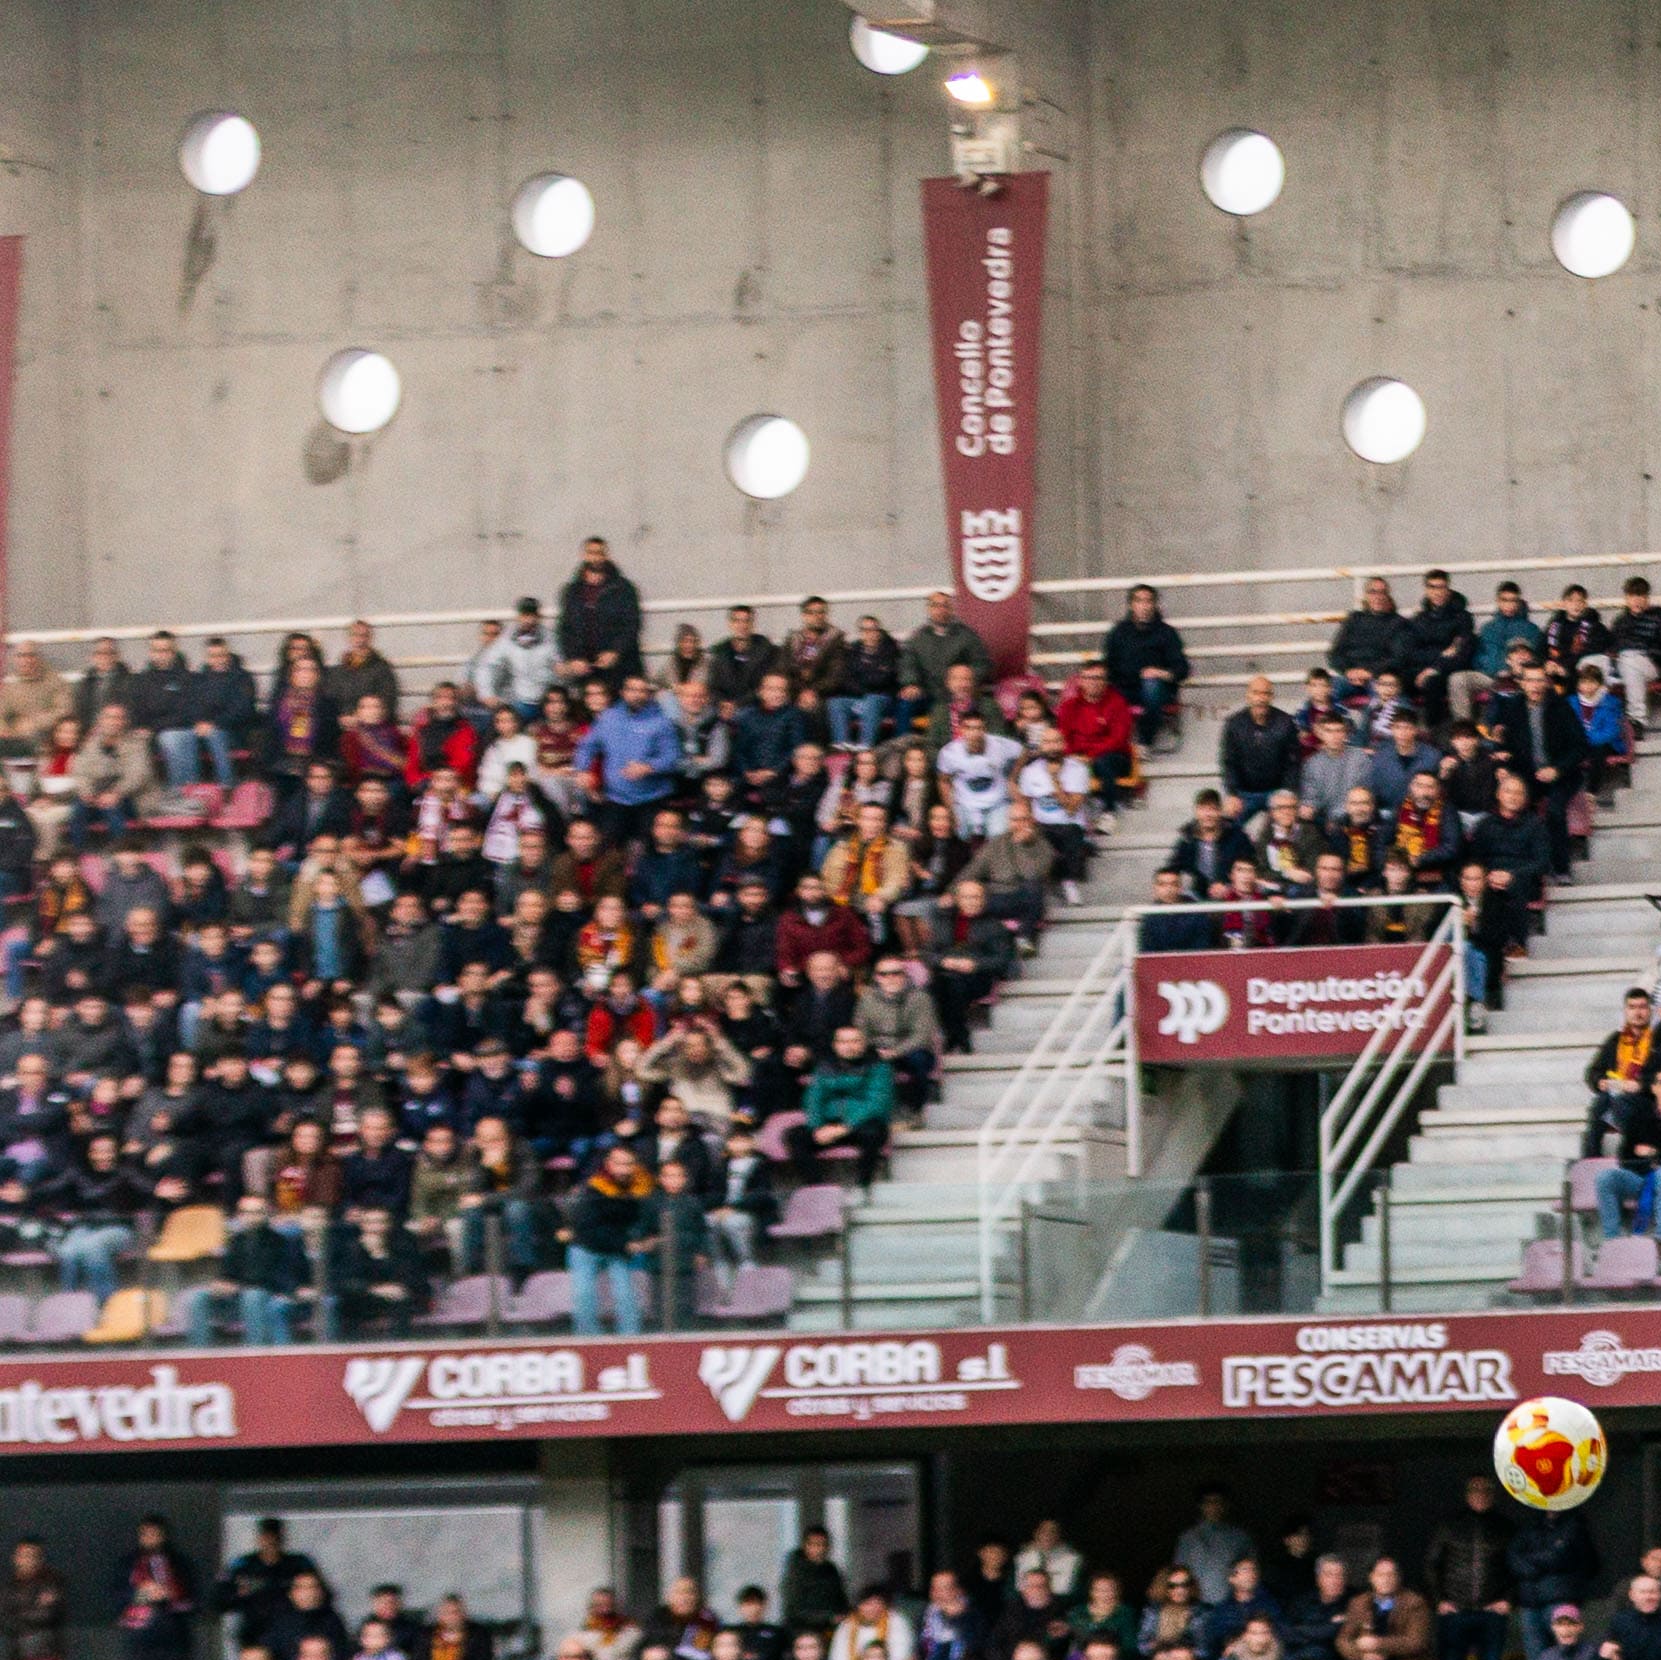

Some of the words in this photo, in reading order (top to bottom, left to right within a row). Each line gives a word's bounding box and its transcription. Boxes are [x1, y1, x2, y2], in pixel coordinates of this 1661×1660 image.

[981, 226, 1015, 409] Pontevedra
[953, 319, 986, 458] Concello
[984, 413, 1016, 456] de
[1245, 970, 1426, 1011] Deputación
[1246, 1003, 1426, 1036] Pontevedra
[1296, 1323, 1448, 1352] CONSERVAS
[426, 1350, 583, 1400] CORBA
[783, 1340, 942, 1388] CORBA
[1221, 1349, 1518, 1408] PESCAMAR
